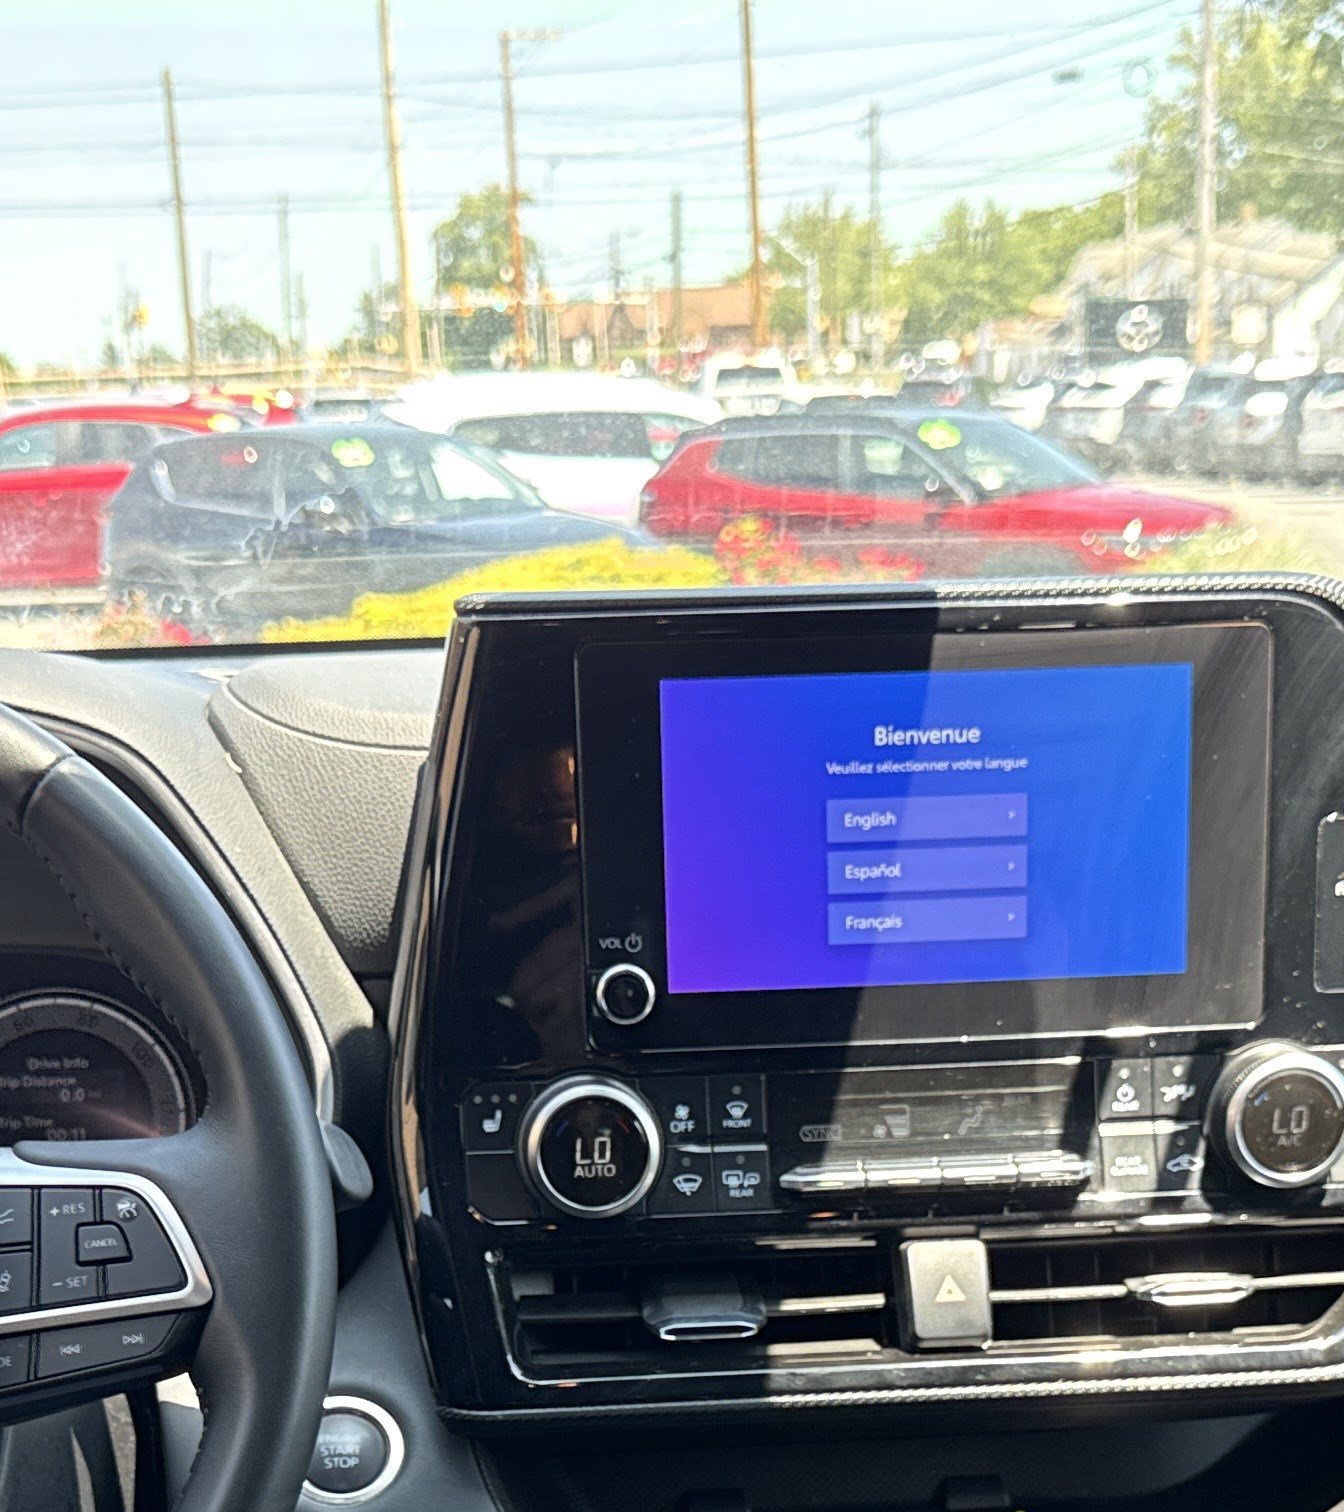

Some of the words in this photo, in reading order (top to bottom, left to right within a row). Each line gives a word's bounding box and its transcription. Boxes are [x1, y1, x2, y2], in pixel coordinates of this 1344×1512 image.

[874, 725, 981, 746] Bienvenue
[826, 762, 872, 774] Veuillez
[876, 759, 949, 774] sélectionner
[952, 759, 983, 770] votre
[985, 757, 1028, 772] langue
[844, 812, 897, 830] English
[845, 864, 900, 881] Español
[845, 914, 903, 932] Français
[599, 937, 623, 949] VOL
[669, 1120, 696, 1133] OFF
[722, 1118, 752, 1128] FRONT
[573, 1164, 616, 1178] AUTO
[729, 1188, 755, 1198] REAR
[84, 1237, 118, 1249] CANCEL
[323, 1457, 359, 1469] STOP
